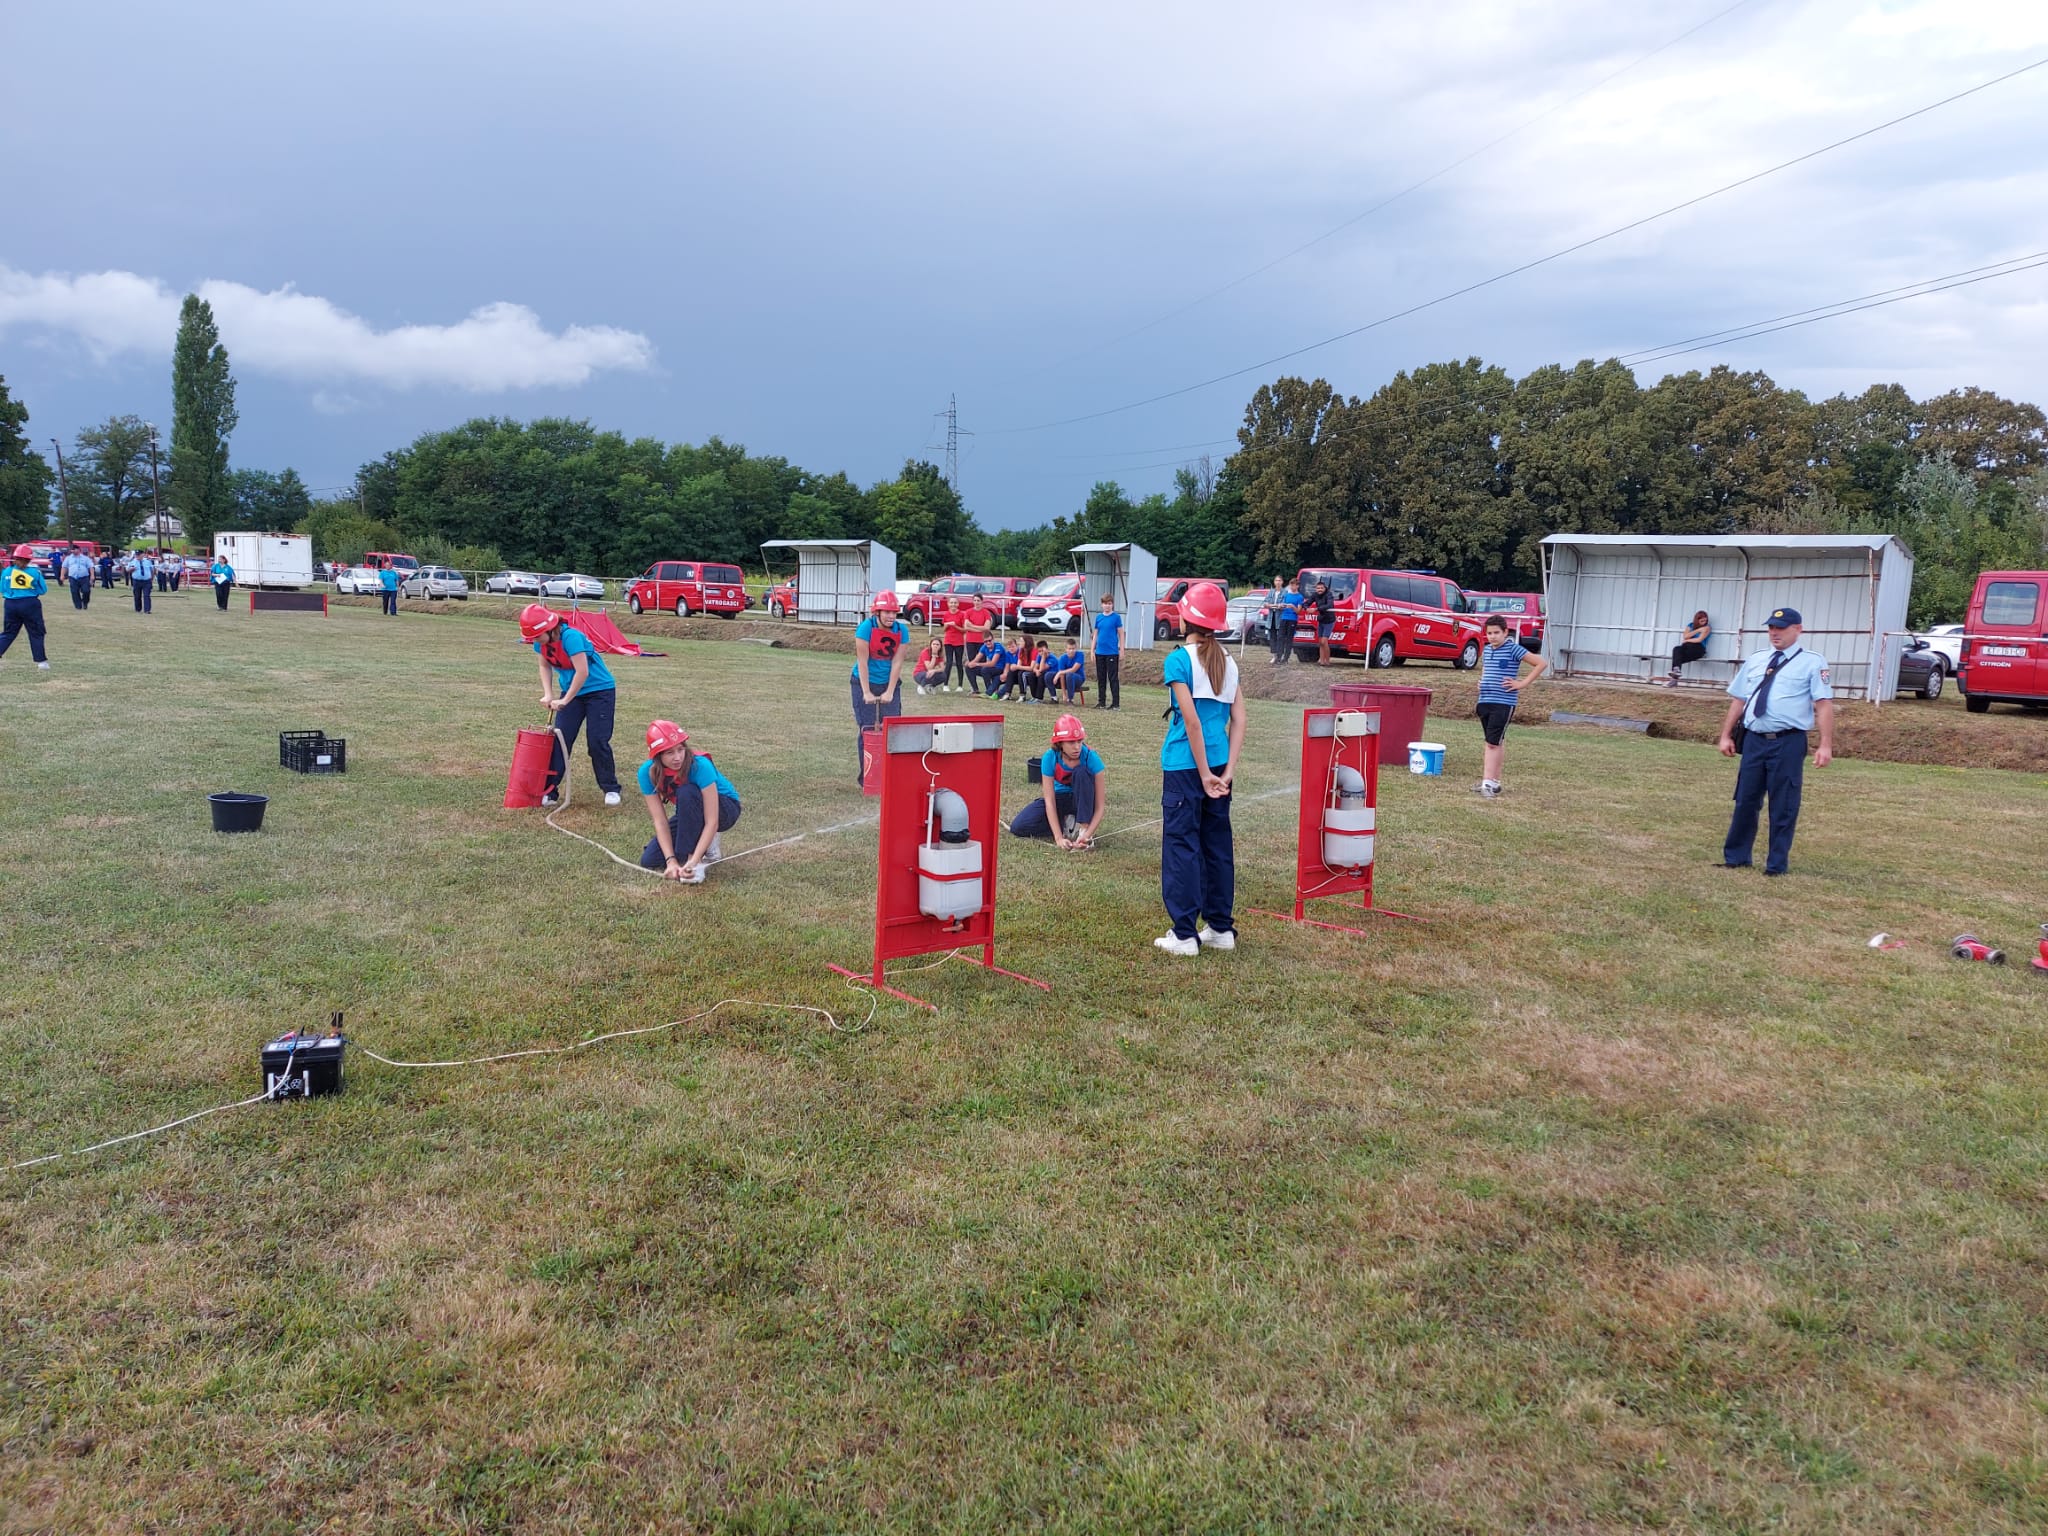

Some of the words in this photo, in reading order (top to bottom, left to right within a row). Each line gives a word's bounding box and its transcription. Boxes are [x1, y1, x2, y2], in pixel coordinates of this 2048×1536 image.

[15, 574, 26, 586] 6
[1416, 623, 1431, 634] 193
[1328, 631, 1346, 640] 193
[877, 636, 896, 657] 3
